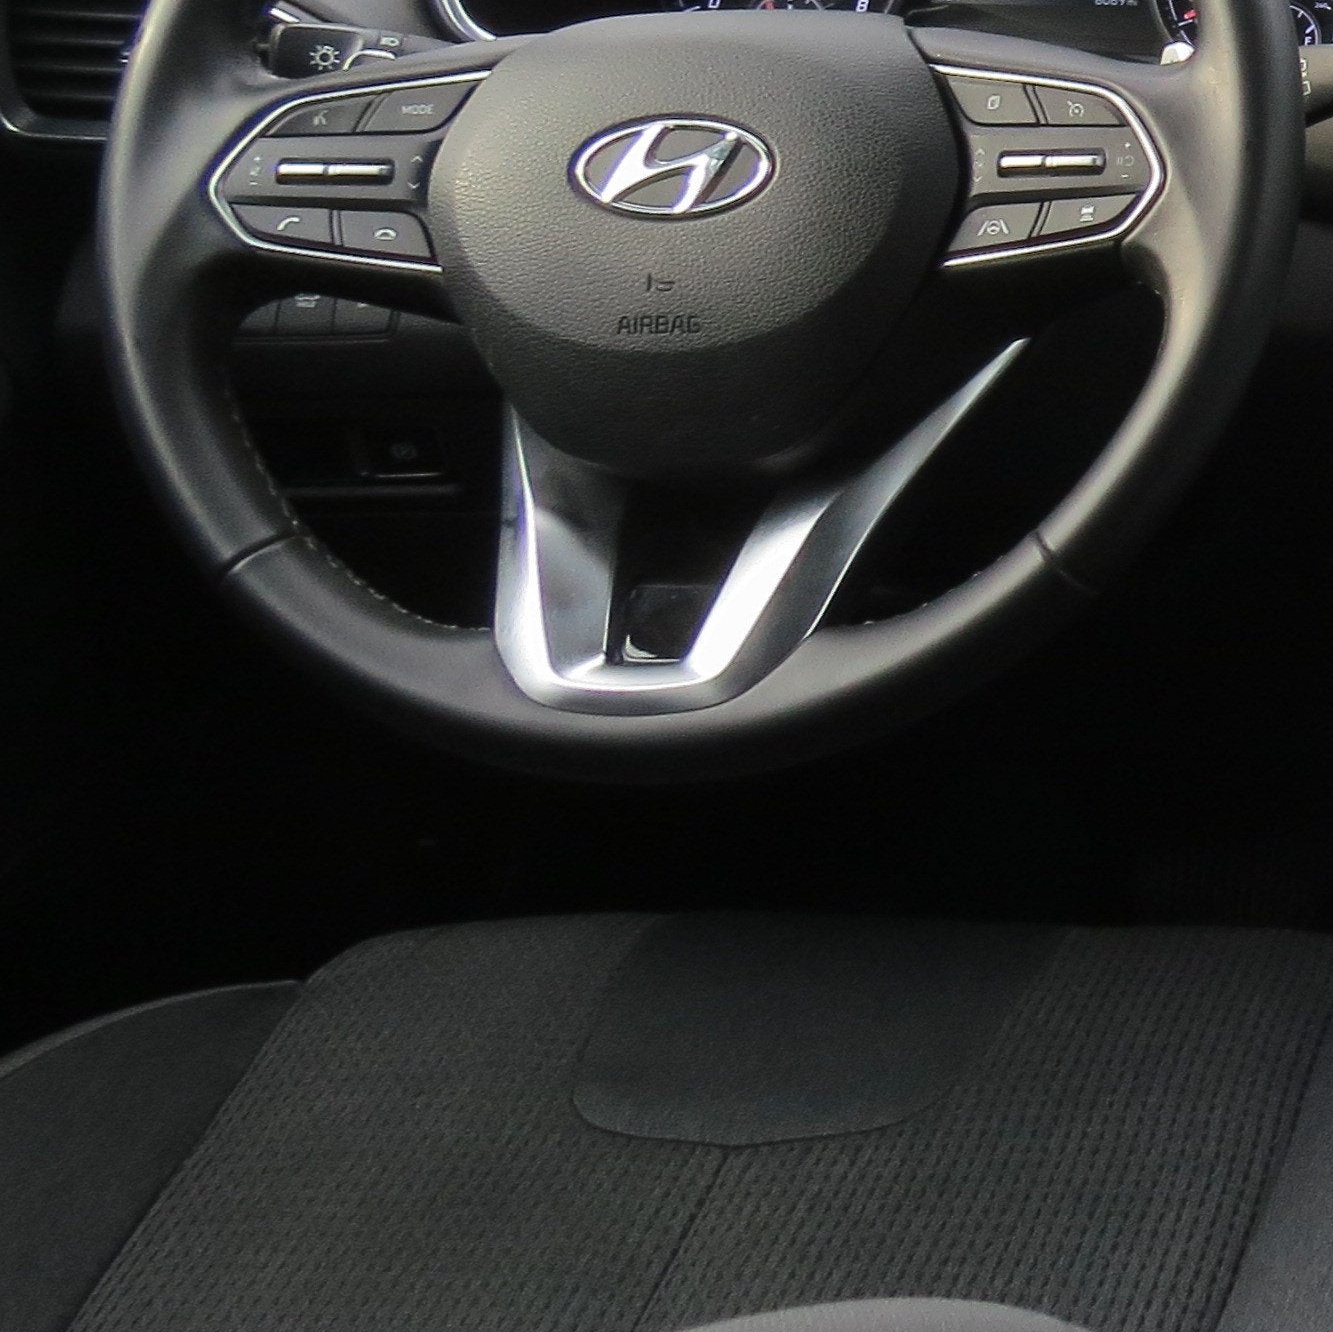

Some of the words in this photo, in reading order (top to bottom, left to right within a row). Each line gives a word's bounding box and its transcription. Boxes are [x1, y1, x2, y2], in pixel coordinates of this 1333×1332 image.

[856, 0, 869, 12] 8
[1304, 36, 1312, 45] F
[402, 104, 434, 115] MODE
[616, 314, 700, 335] AIRBAG
